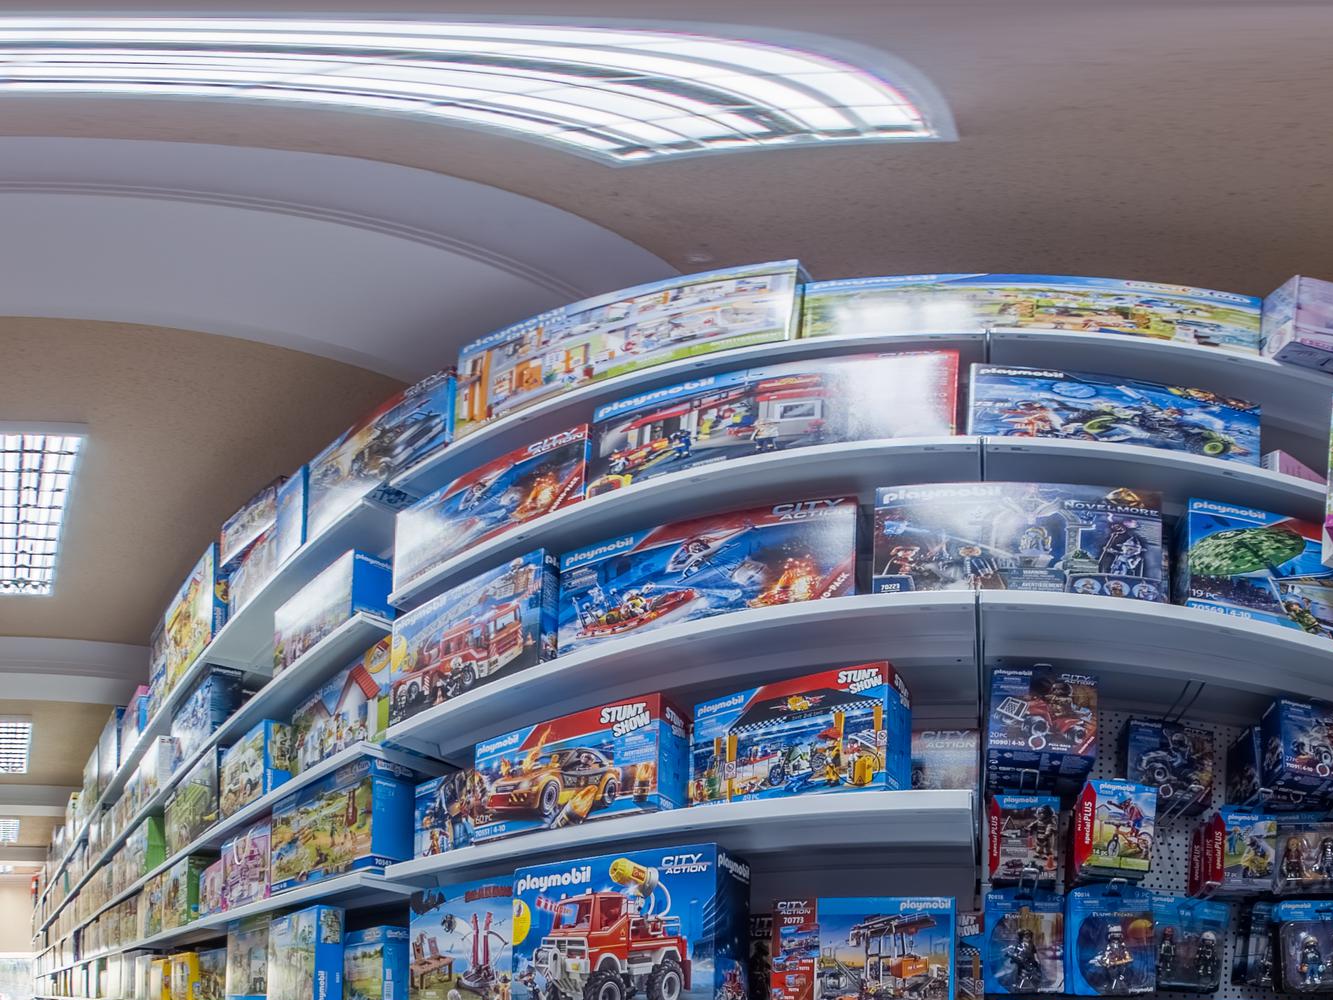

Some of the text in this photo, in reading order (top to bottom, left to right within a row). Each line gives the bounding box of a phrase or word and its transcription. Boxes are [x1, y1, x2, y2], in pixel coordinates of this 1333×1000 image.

[980, 366, 1064, 379] playmobil
[599, 376, 715, 417] playmobil
[883, 485, 1000, 504] playmobil
[772, 498, 845, 518] CITY
[1193, 501, 1266, 520] playmobil
[565, 538, 634, 567] playmobil
[1192, 589, 1218, 600] 19 PC
[838, 669, 880, 685] STUNT
[994, 669, 1032, 677] playmobil
[848, 674, 883, 694] SHOW
[600, 702, 648, 726] STUNT
[697, 694, 745, 717] playmobil
[613, 713, 651, 738] SHOW
[476, 734, 520, 760] playmobil
[1100, 784, 1136, 792] playmobil
[1084, 800, 1092, 845] specialPLUS
[661, 852, 703, 867] CITY
[665, 863, 708, 875] ACTION
[718, 853, 750, 879] playmobil
[517, 866, 592, 894] playmobil
[777, 901, 808, 911] CITY
[900, 900, 951, 910] playmobil
